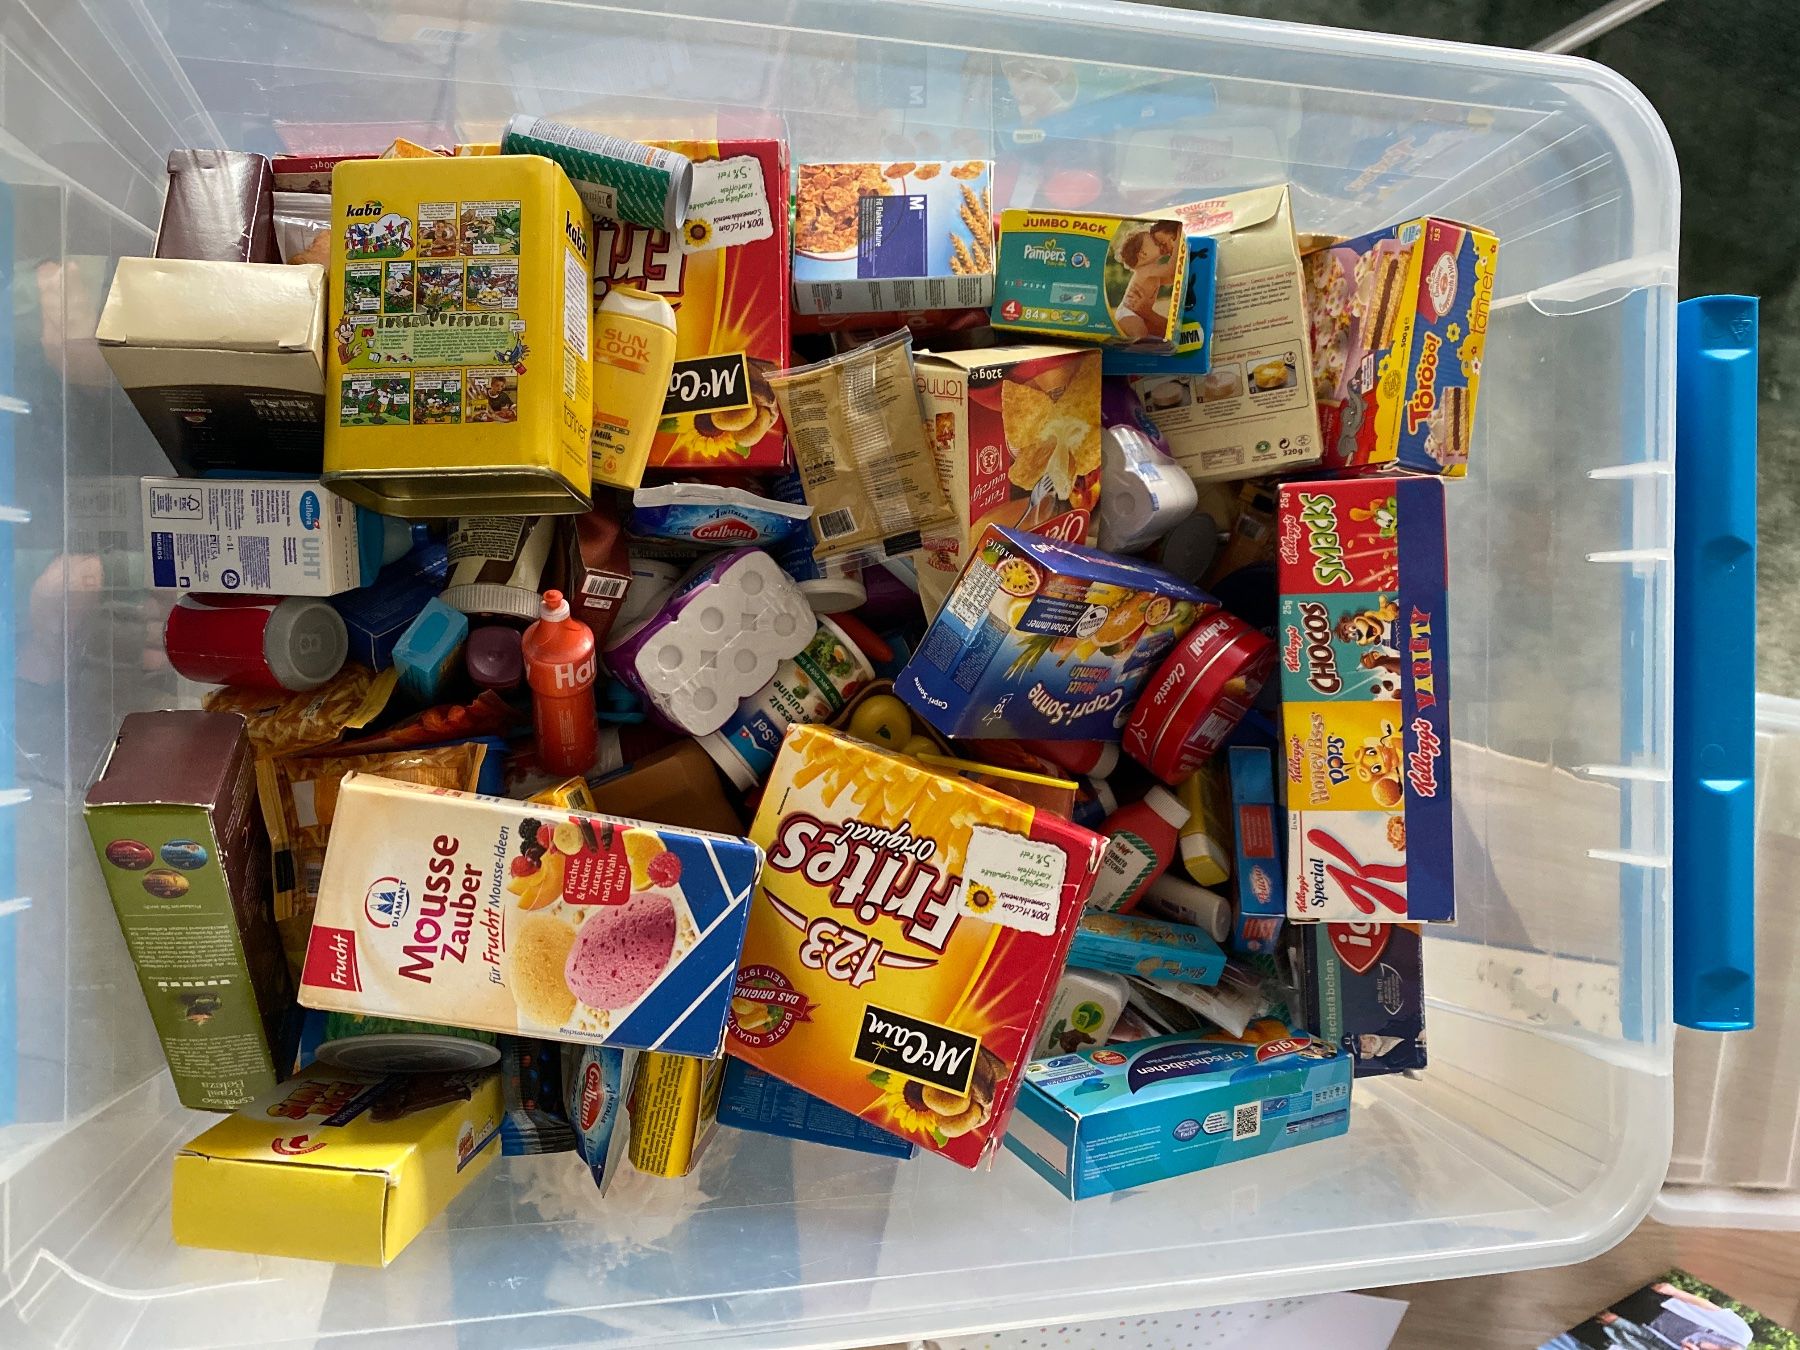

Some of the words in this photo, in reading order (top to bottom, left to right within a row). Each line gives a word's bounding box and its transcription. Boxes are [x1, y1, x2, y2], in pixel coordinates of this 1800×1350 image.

[346, 203, 382, 217] kaba
[1022, 217, 1069, 229] JUMBO
[1072, 220, 1108, 234] PACK
[565, 210, 588, 260] kaba
[594, 230, 684, 297] Fri
[1023, 244, 1067, 264] Pampers
[1006, 301, 1015, 314] 4
[1024, 309, 1039, 320] 84
[1470, 269, 1494, 335] tanner
[595, 339, 651, 363] LOOK
[603, 328, 648, 349] SUN
[668, 363, 741, 402] McCa
[917, 377, 963, 407] tanne
[563, 401, 587, 443] tanner
[595, 430, 613, 442] Milk
[304, 496, 314, 526] Valflora
[1281, 492, 1290, 508] 25g
[155, 534, 163, 561] MIGROS
[694, 525, 754, 542] Galbani
[1280, 514, 1301, 565] Kellogg's
[302, 537, 321, 580] UHT
[1283, 600, 1293, 615] 25g
[1189, 619, 1230, 657] Pulmoll
[1283, 626, 1303, 673] Kellogg's
[1298, 602, 1343, 696] CHOCOS
[1409, 605, 1437, 712] VARIETY
[913, 676, 948, 710] Capri-Sonne
[1154, 663, 1186, 705] Classic
[1027, 681, 1123, 726] Capri-Sonne
[1288, 734, 1305, 785] Kellogg's
[1407, 718, 1441, 798] Kellogg's
[842, 822, 936, 860] Original
[491, 825, 510, 909] Mousse-Ideen
[578, 857, 593, 891] leckere
[605, 852, 618, 878] Wahl
[1035, 853, 1051, 867] 5%
[1107, 850, 1129, 868] TOMATO
[1307, 829, 1407, 914] K
[566, 859, 581, 895] Früchte
[588, 858, 605, 897] Zutaten
[601, 879, 611, 902] nach
[615, 864, 629, 892] dazu!
[770, 817, 960, 948] Frites
[1297, 874, 1310, 914] Kellogg's
[1309, 857, 1329, 908] Special
[391, 879, 407, 928] DIAMANT
[398, 834, 460, 984] Mousse
[440, 863, 484, 964] Zauber
[1002, 902, 1032, 919] McCain
[1031, 908, 1050, 922] 100%
[482, 908, 503, 966] Frucht
[330, 933, 350, 987] Frucht
[488, 965, 504, 987] für
[736, 969, 761, 982] 1979
[734, 986, 776, 1000] ORIGINA
[763, 970, 787, 988] SEIT
[777, 992, 800, 1005] DAS
[766, 1012, 793, 1043] BESTE
[867, 1013, 971, 1076] McCain
[1266, 1038, 1299, 1056] iglo
[1136, 1053, 1232, 1076] Fischstäbchen
[201, 1095, 255, 1106] ESPRESSO
[580, 1061, 600, 1131] Galbani
